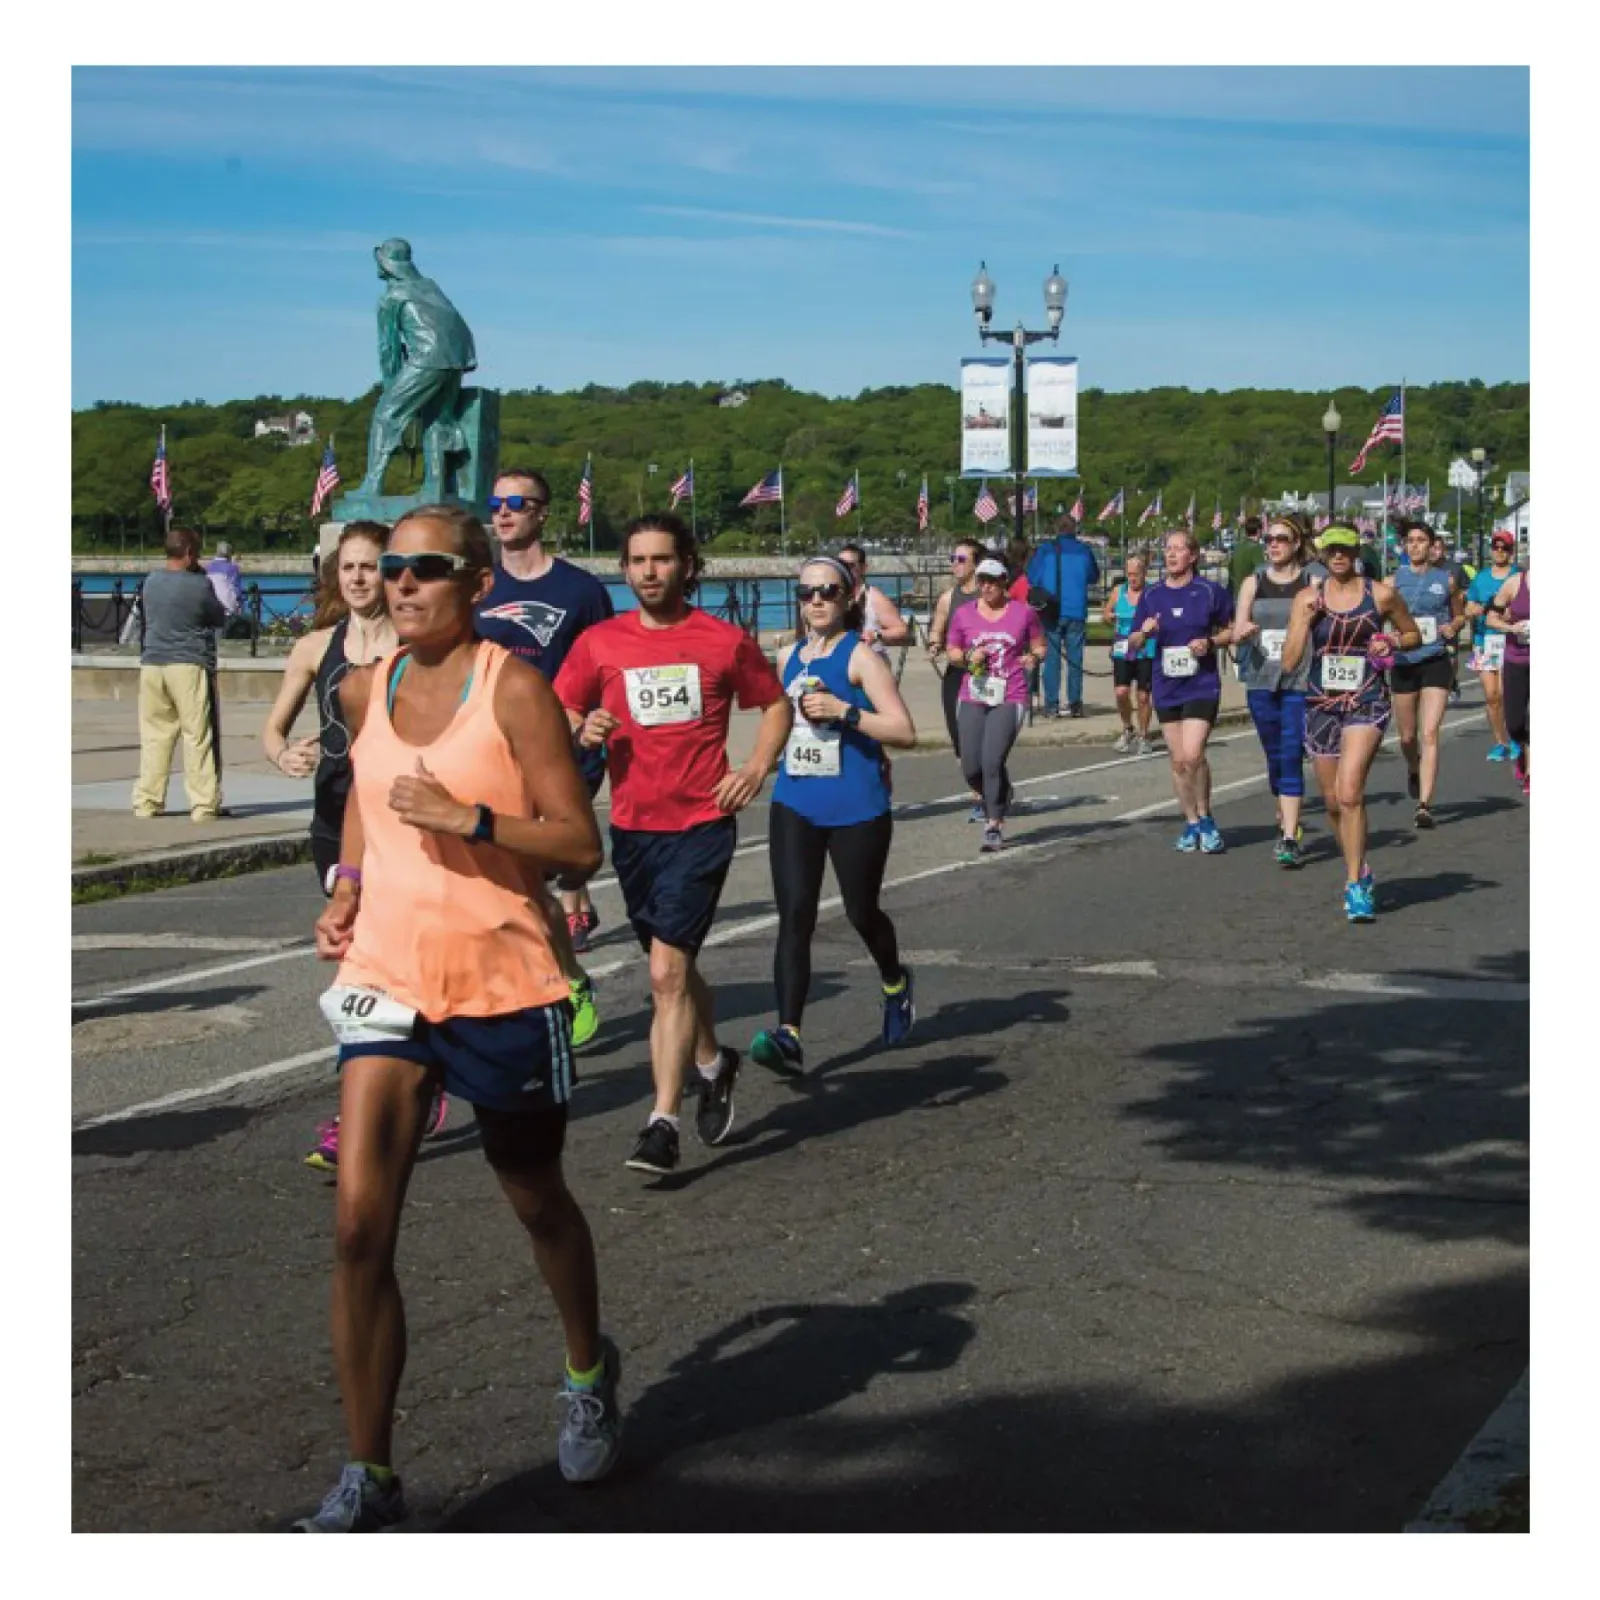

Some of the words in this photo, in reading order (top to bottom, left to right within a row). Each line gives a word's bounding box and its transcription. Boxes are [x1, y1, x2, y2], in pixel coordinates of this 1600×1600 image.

[1328, 667, 1358, 681] 925
[638, 685, 691, 709] 954
[793, 746, 822, 765] 445
[341, 992, 378, 1018] 40
